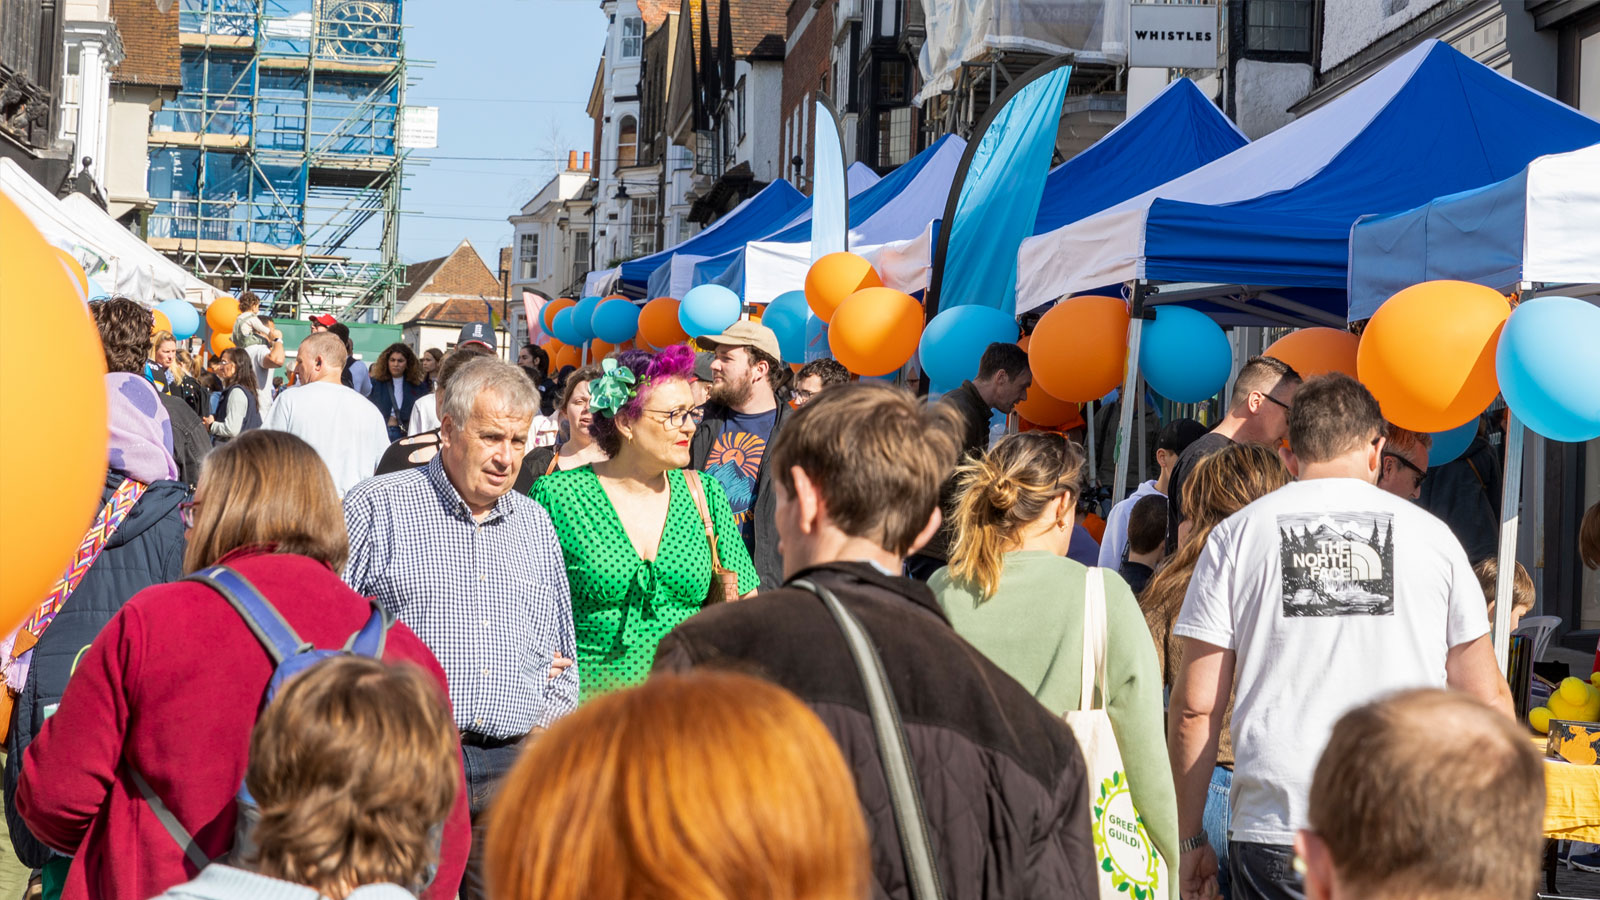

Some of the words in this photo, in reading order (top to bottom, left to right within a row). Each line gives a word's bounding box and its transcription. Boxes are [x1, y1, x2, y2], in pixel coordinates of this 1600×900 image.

[1135, 30, 1212, 42] WHISTLES
[1317, 540, 1351, 554] THE
[1292, 552, 1351, 568] NORTH
[1310, 567, 1351, 581] FACE
